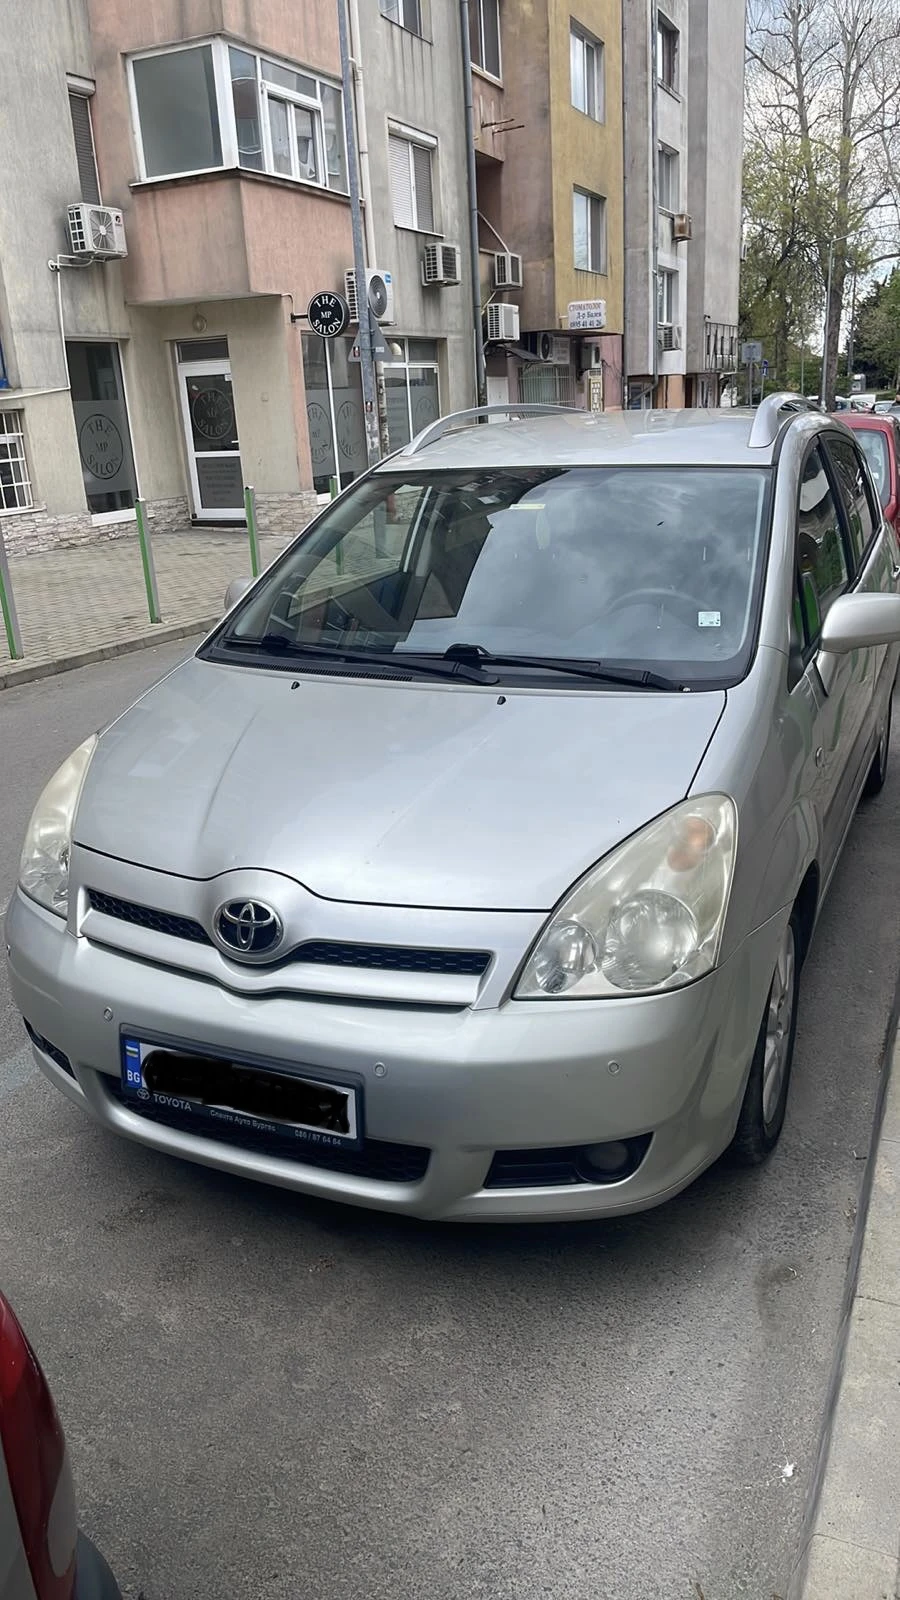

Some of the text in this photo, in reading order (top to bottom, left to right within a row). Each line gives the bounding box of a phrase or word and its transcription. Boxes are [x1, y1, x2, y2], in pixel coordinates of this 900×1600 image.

[314, 295, 337, 308] THE
[320, 311, 332, 319] MP
[313, 318, 341, 334] SALON
[87, 419, 113, 437] THE
[96, 442, 109, 453] MP
[87, 454, 119, 475] SALON
[127, 1069, 140, 1083] BG
[153, 1093, 192, 1111] TOYOTA
